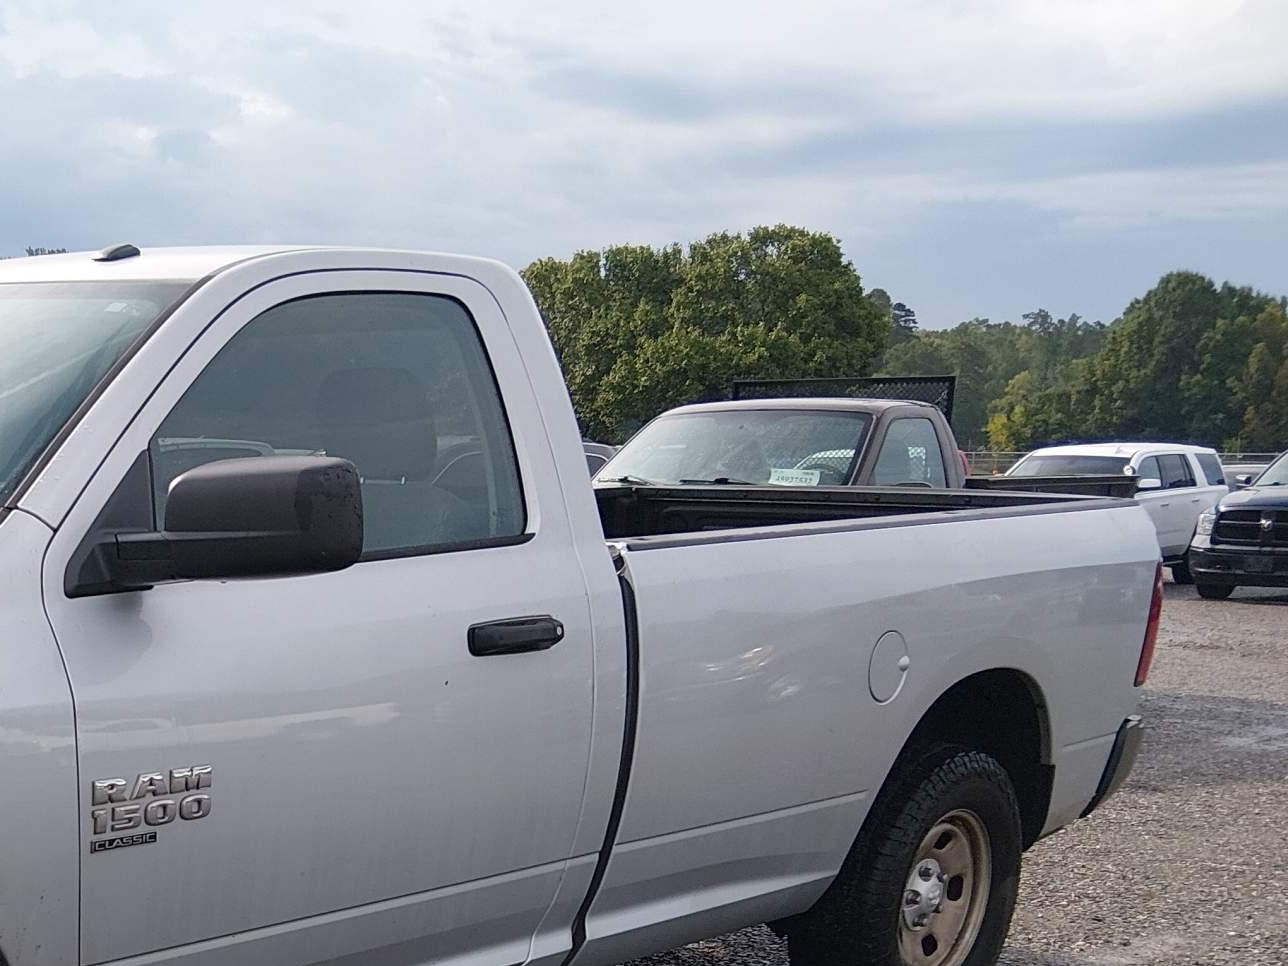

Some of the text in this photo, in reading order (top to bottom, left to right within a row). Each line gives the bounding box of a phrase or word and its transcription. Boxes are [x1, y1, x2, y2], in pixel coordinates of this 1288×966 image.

[92, 764, 213, 806] RAM
[91, 793, 212, 835] 1500
[94, 832, 156, 851] CLASSIC
